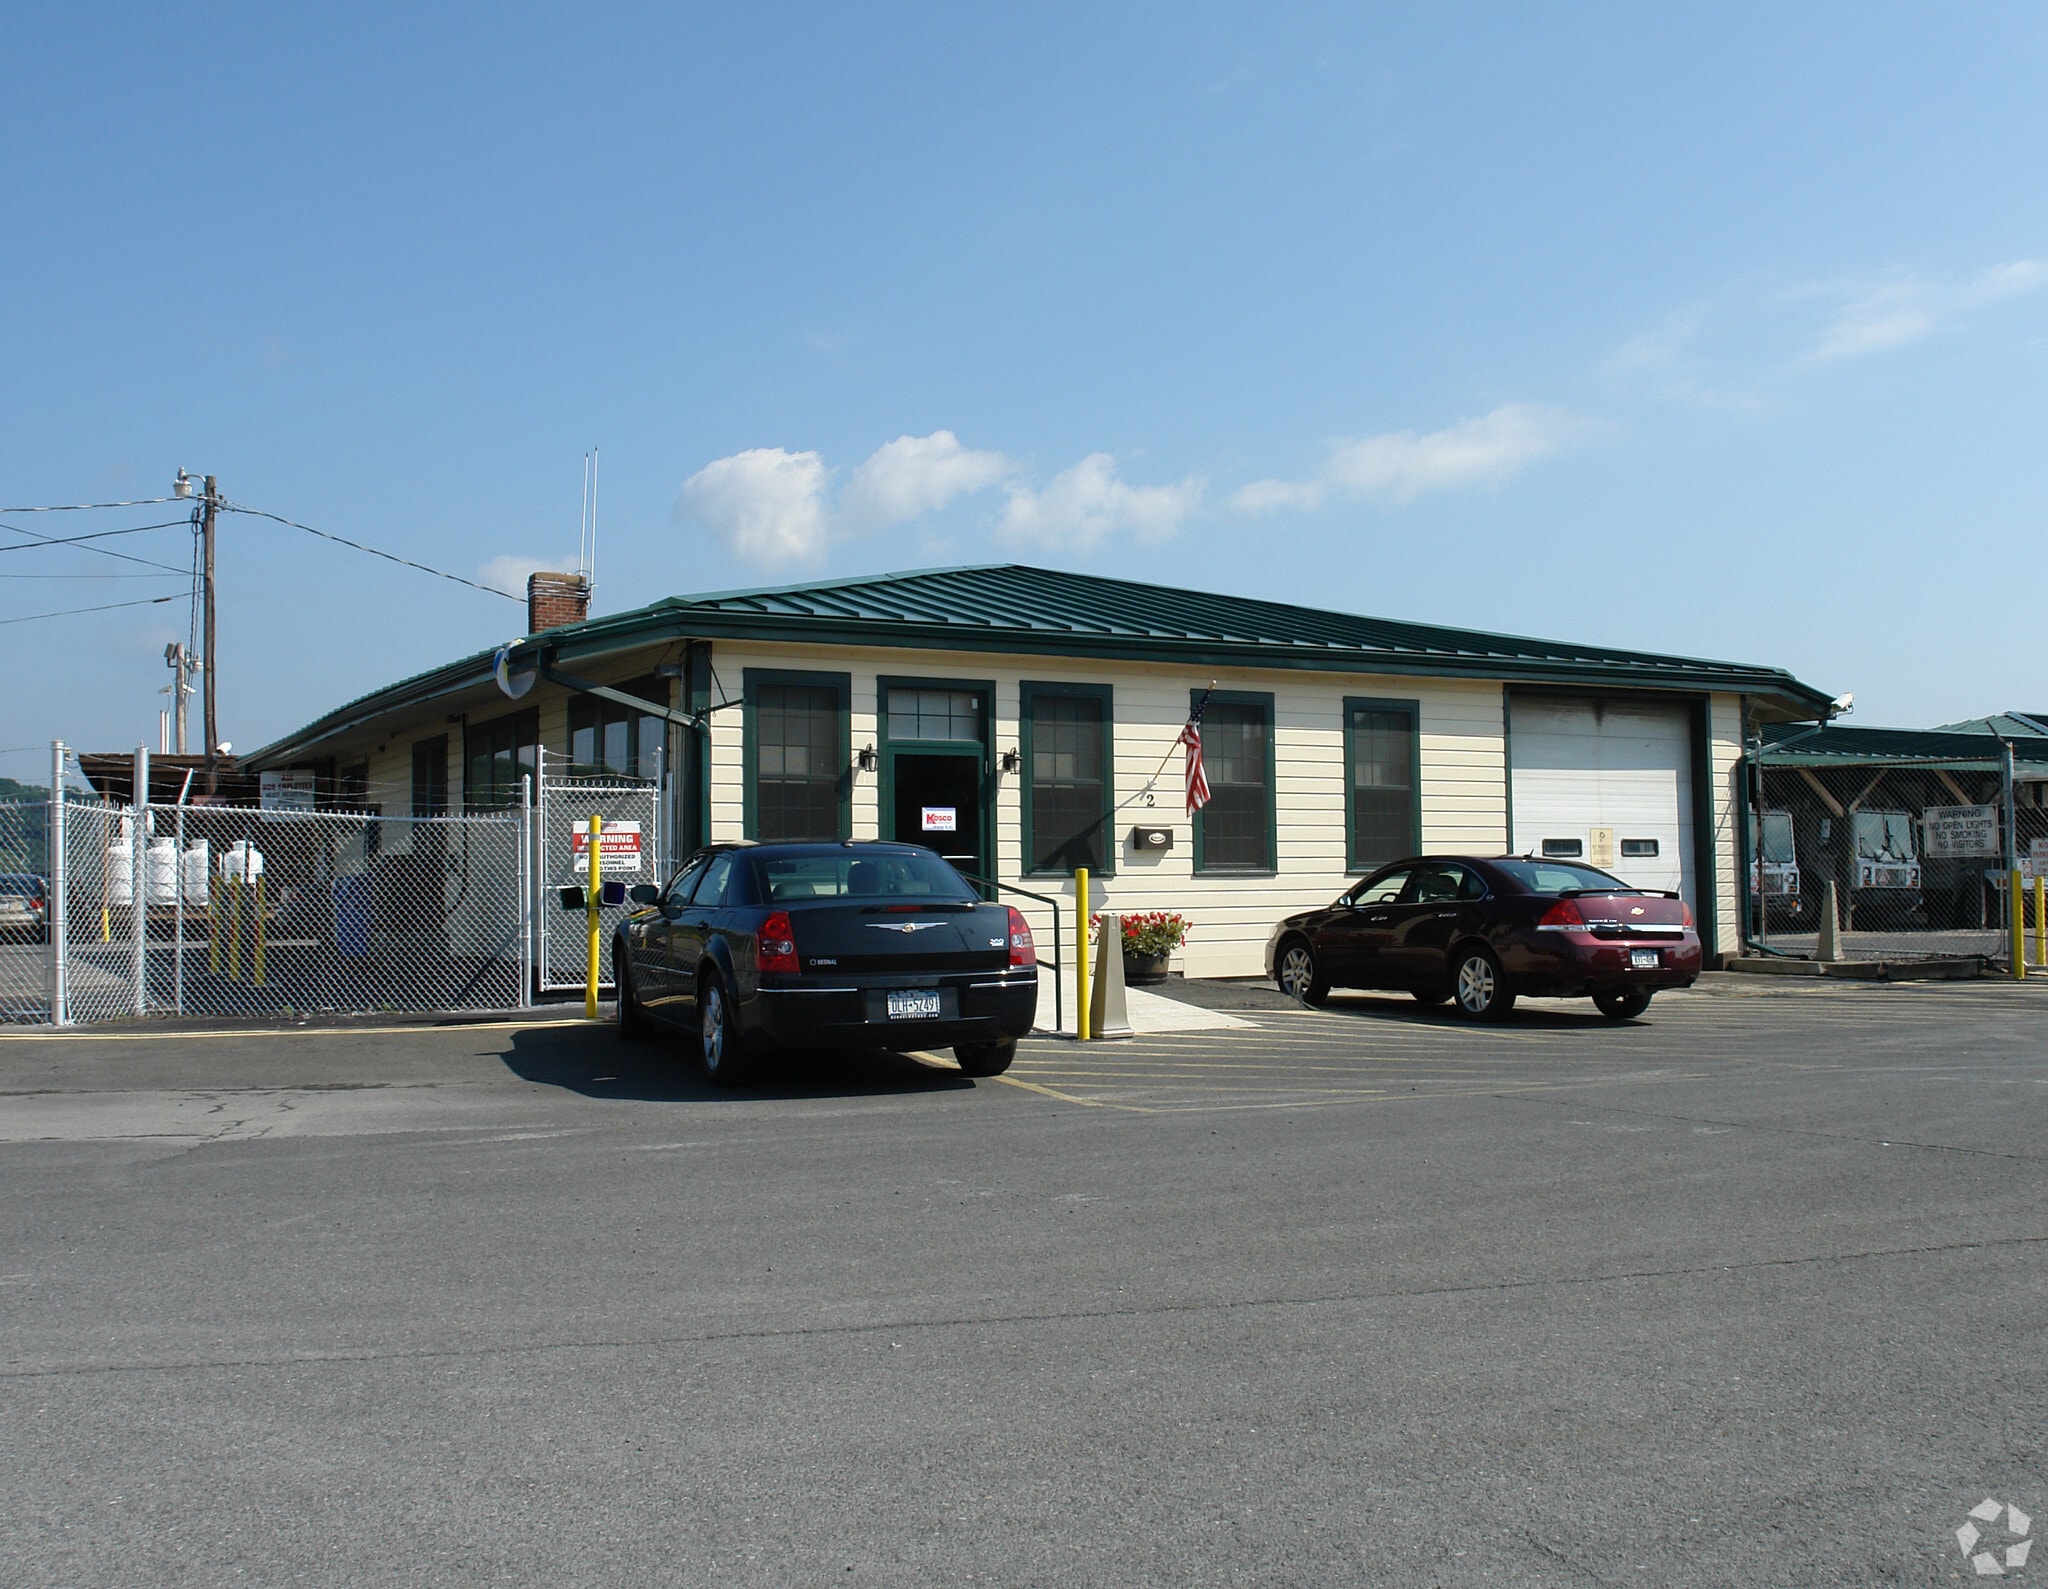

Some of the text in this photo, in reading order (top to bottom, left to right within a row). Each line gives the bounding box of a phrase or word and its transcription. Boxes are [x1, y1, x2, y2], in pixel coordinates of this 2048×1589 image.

[1146, 794, 1155, 807] 2
[1938, 809, 1982, 818] WARNING
[1929, 819, 1993, 831] NO OPEN LIGHTS
[581, 834, 634, 844] WRNING
[1936, 830, 1987, 840] NO SMOKING
[1938, 839, 1985, 849] NO VISITORS
